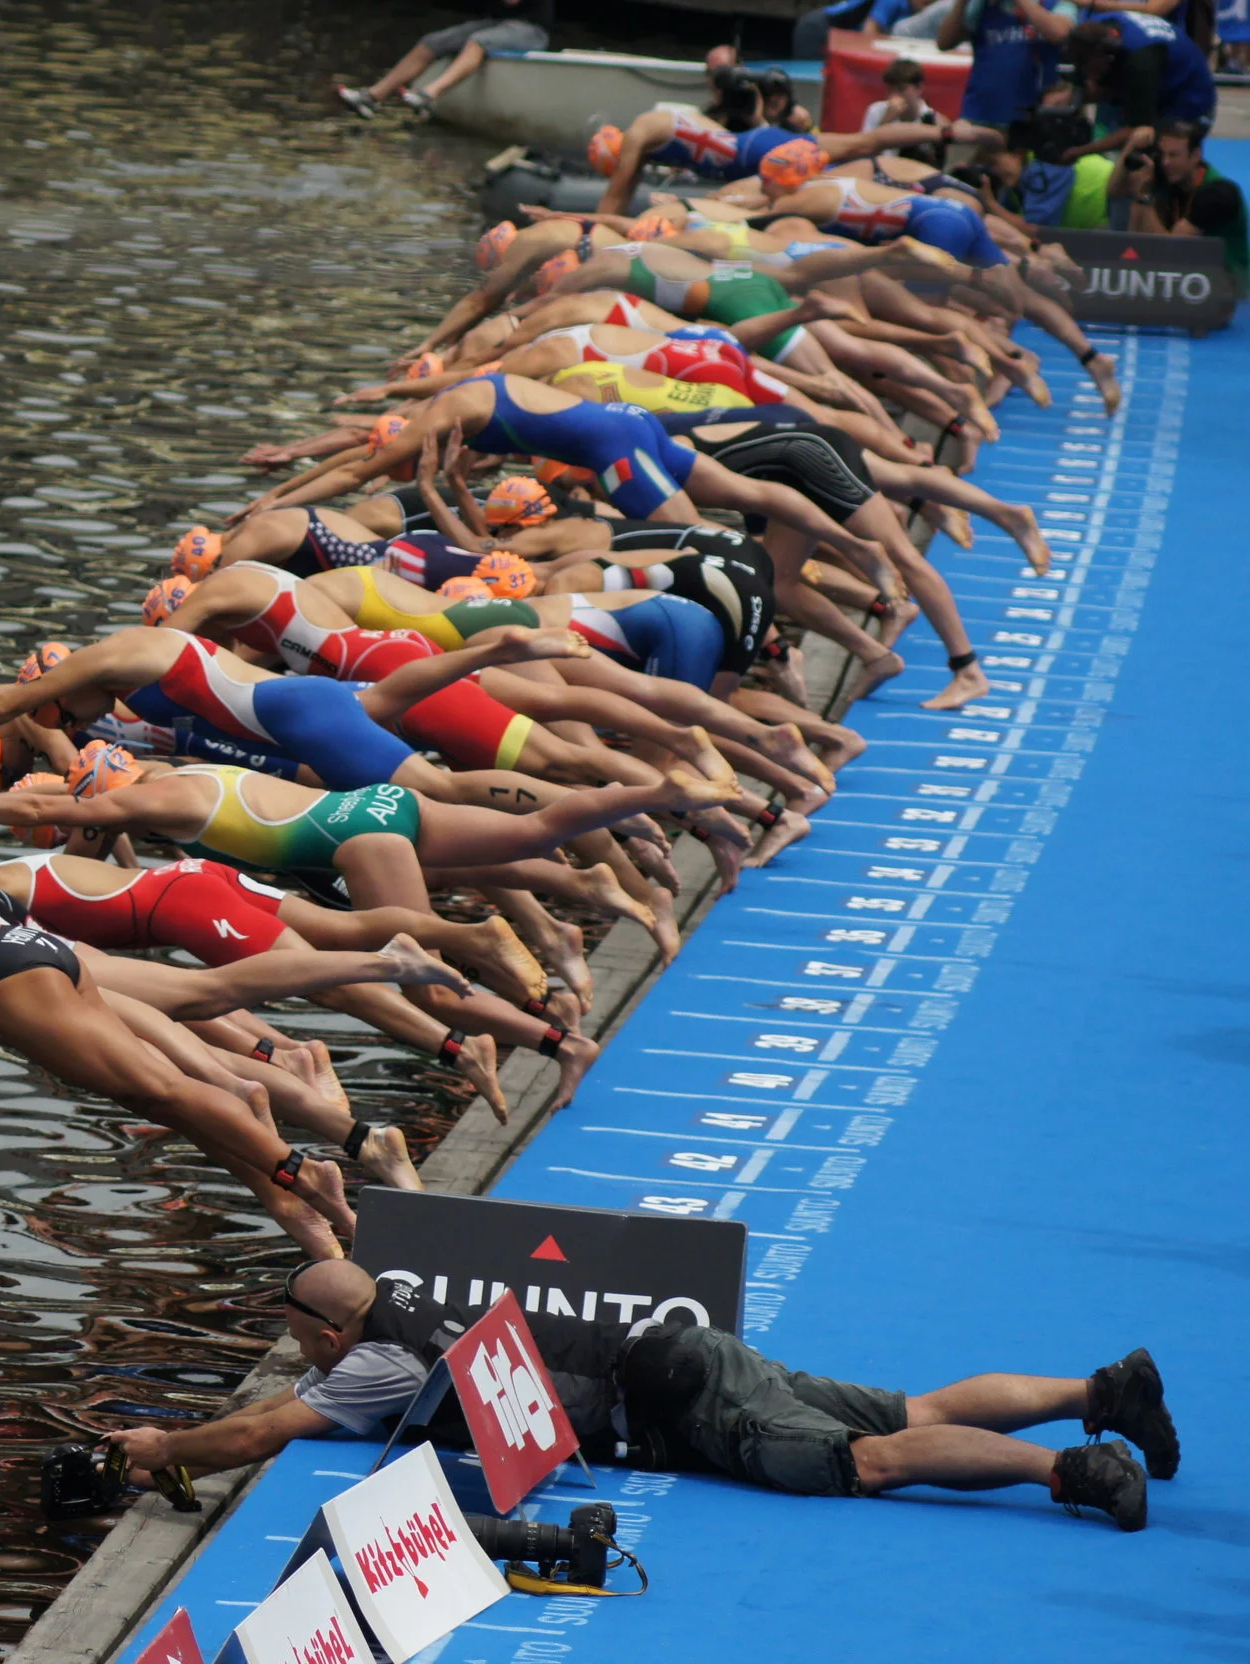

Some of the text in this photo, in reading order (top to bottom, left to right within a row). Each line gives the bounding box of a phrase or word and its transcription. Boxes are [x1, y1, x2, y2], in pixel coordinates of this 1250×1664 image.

[1055, 267, 1212, 305] UUNTO
[191, 536, 207, 557] 40
[366, 783, 406, 826] AUS
[846, 896, 906, 912] 35
[826, 929, 886, 945] 36
[804, 961, 864, 978] 37
[780, 997, 841, 1014] 38
[755, 1034, 819, 1053] 39
[728, 1072, 794, 1089] 40
[701, 1112, 767, 1130] 41
[669, 1152, 738, 1172] 42
[808, 1156, 868, 1190] SUUNTO
[639, 1195, 709, 1215] 43
[784, 1198, 842, 1233] SUUNTO
[753, 1243, 813, 1281] SUUNTO
[744, 1292, 786, 1333] SUUNTO
[620, 1471, 680, 1497] SUU
[537, 1597, 602, 1626] SUU
